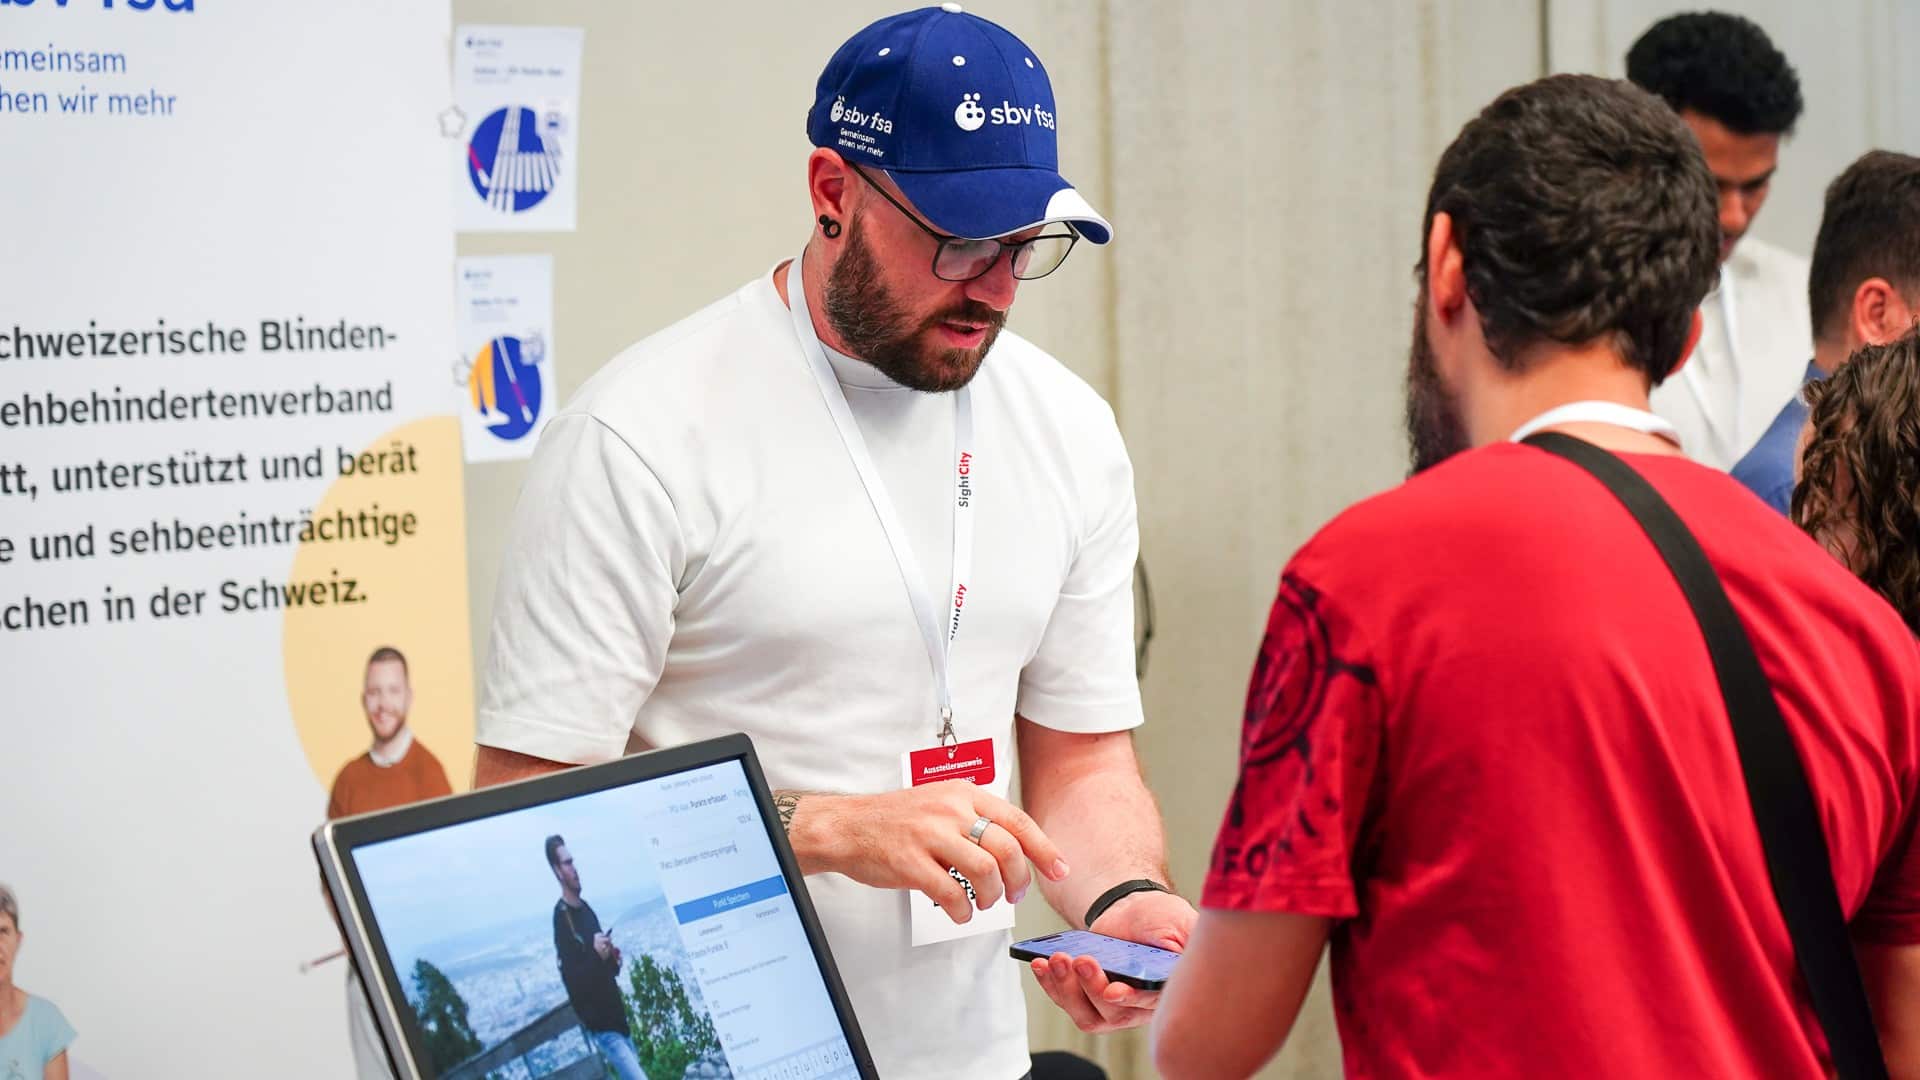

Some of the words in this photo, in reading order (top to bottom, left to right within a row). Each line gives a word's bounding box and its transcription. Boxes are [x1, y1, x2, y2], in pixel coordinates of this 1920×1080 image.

[0, 43, 126, 73] meinsam
[57, 85, 99, 113] wir
[108, 89, 177, 116] mehr
[990, 100, 1032, 125] sbv
[1033, 103, 1055, 130] fsa
[840, 127, 876, 144] Gemeinsam
[843, 106, 869, 126] sbv
[870, 112, 893, 134] fsa
[856, 142, 867, 151] wir
[866, 146, 884, 158] mehr
[260, 317, 397, 352] Blinden-
[0, 382, 393, 428] ehbehindertenverband
[52, 450, 249, 493] unterstützt
[261, 447, 323, 481] und
[338, 442, 417, 476] berät
[958, 451, 973, 508] SightCity
[30, 524, 95, 562] und
[110, 505, 417, 554] sehbeeinträchtige
[0, 596, 88, 631] chen
[102, 586, 135, 622] in
[149, 586, 206, 619] der
[220, 570, 367, 612] Schweiz.
[923, 757, 983, 775] Ausstellerausweis
